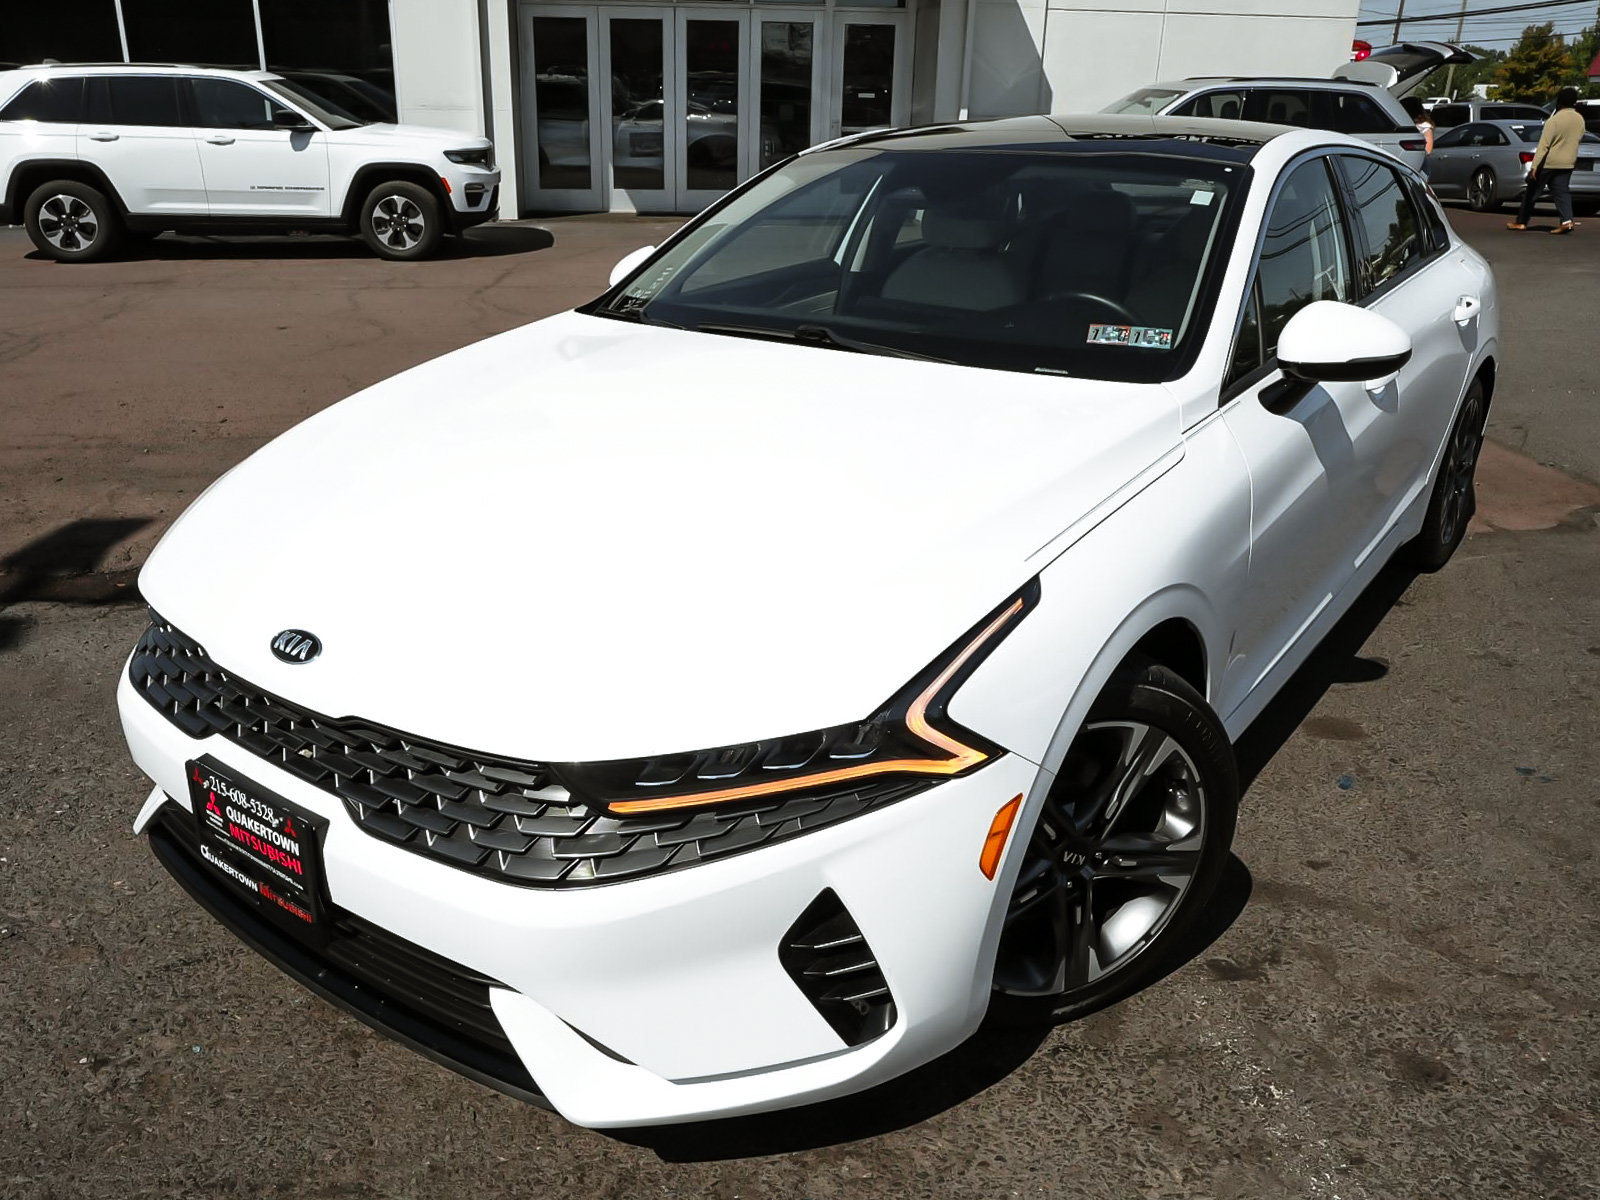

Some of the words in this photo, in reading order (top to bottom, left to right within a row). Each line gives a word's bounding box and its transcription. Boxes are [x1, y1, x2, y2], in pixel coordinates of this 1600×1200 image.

[274, 631, 312, 660] KIA
[209, 775, 275, 824] 215-608-5328
[226, 806, 300, 856] QUAKERTOWN
[229, 822, 303, 875] MITSUBISHI
[1064, 851, 1085, 865] KIA
